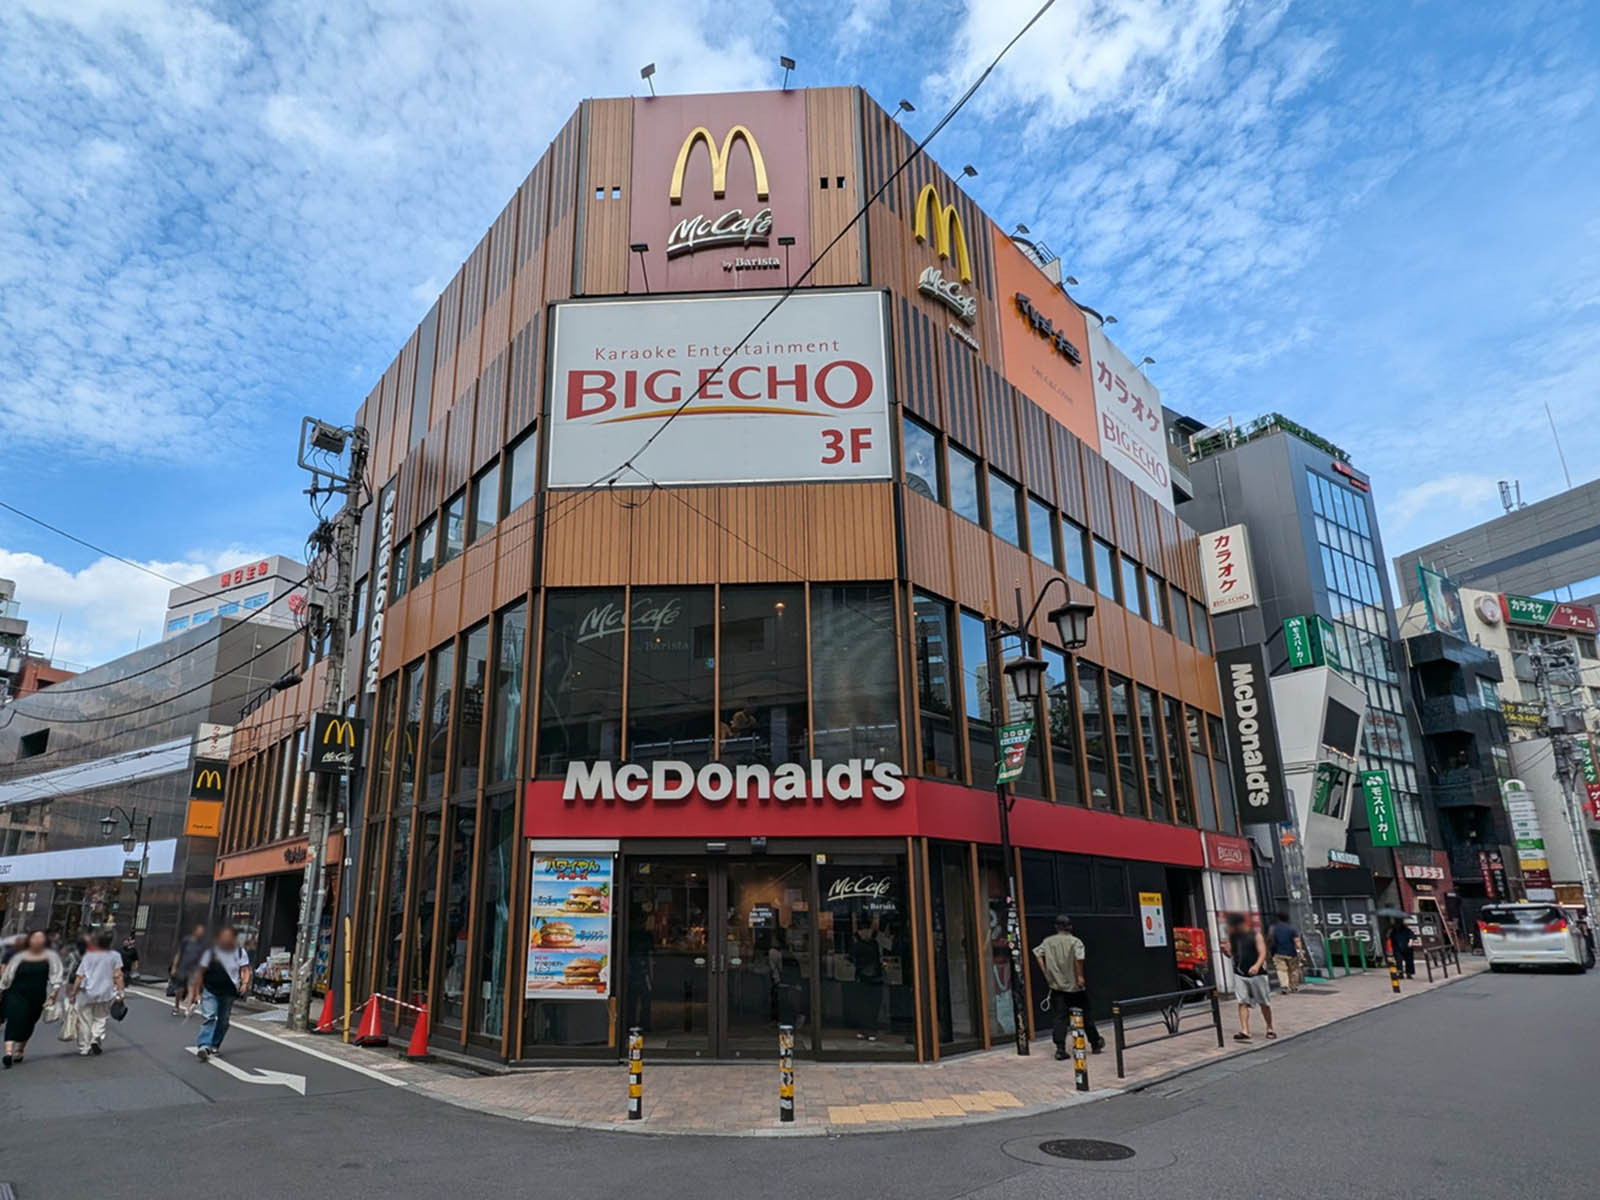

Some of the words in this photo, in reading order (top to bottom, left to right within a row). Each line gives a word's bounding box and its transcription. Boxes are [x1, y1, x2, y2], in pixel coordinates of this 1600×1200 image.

[667, 208, 772, 248] McCafé
[735, 256, 780, 268] Barista
[595, 346, 677, 361] Karaoke
[687, 339, 840, 358] Entertainment
[566, 368, 682, 421] BIG
[697, 360, 874, 410] ECHO
[1097, 360, 1160, 432] カラオケ
[820, 427, 873, 465] 3F
[1102, 411, 1131, 454] BIG
[1132, 440, 1168, 488] ECHO
[1214, 535, 1238, 594] カラオケ
[577, 599, 683, 640] McCafé
[1511, 600, 1544, 614] カラオケ
[1292, 626, 1304, 665] モスバーガー
[1230, 663, 1271, 808] McDonald's
[562, 758, 906, 802] McDonald's
[1371, 787, 1389, 841] モスバーガー
[828, 876, 890, 898] McCafé
